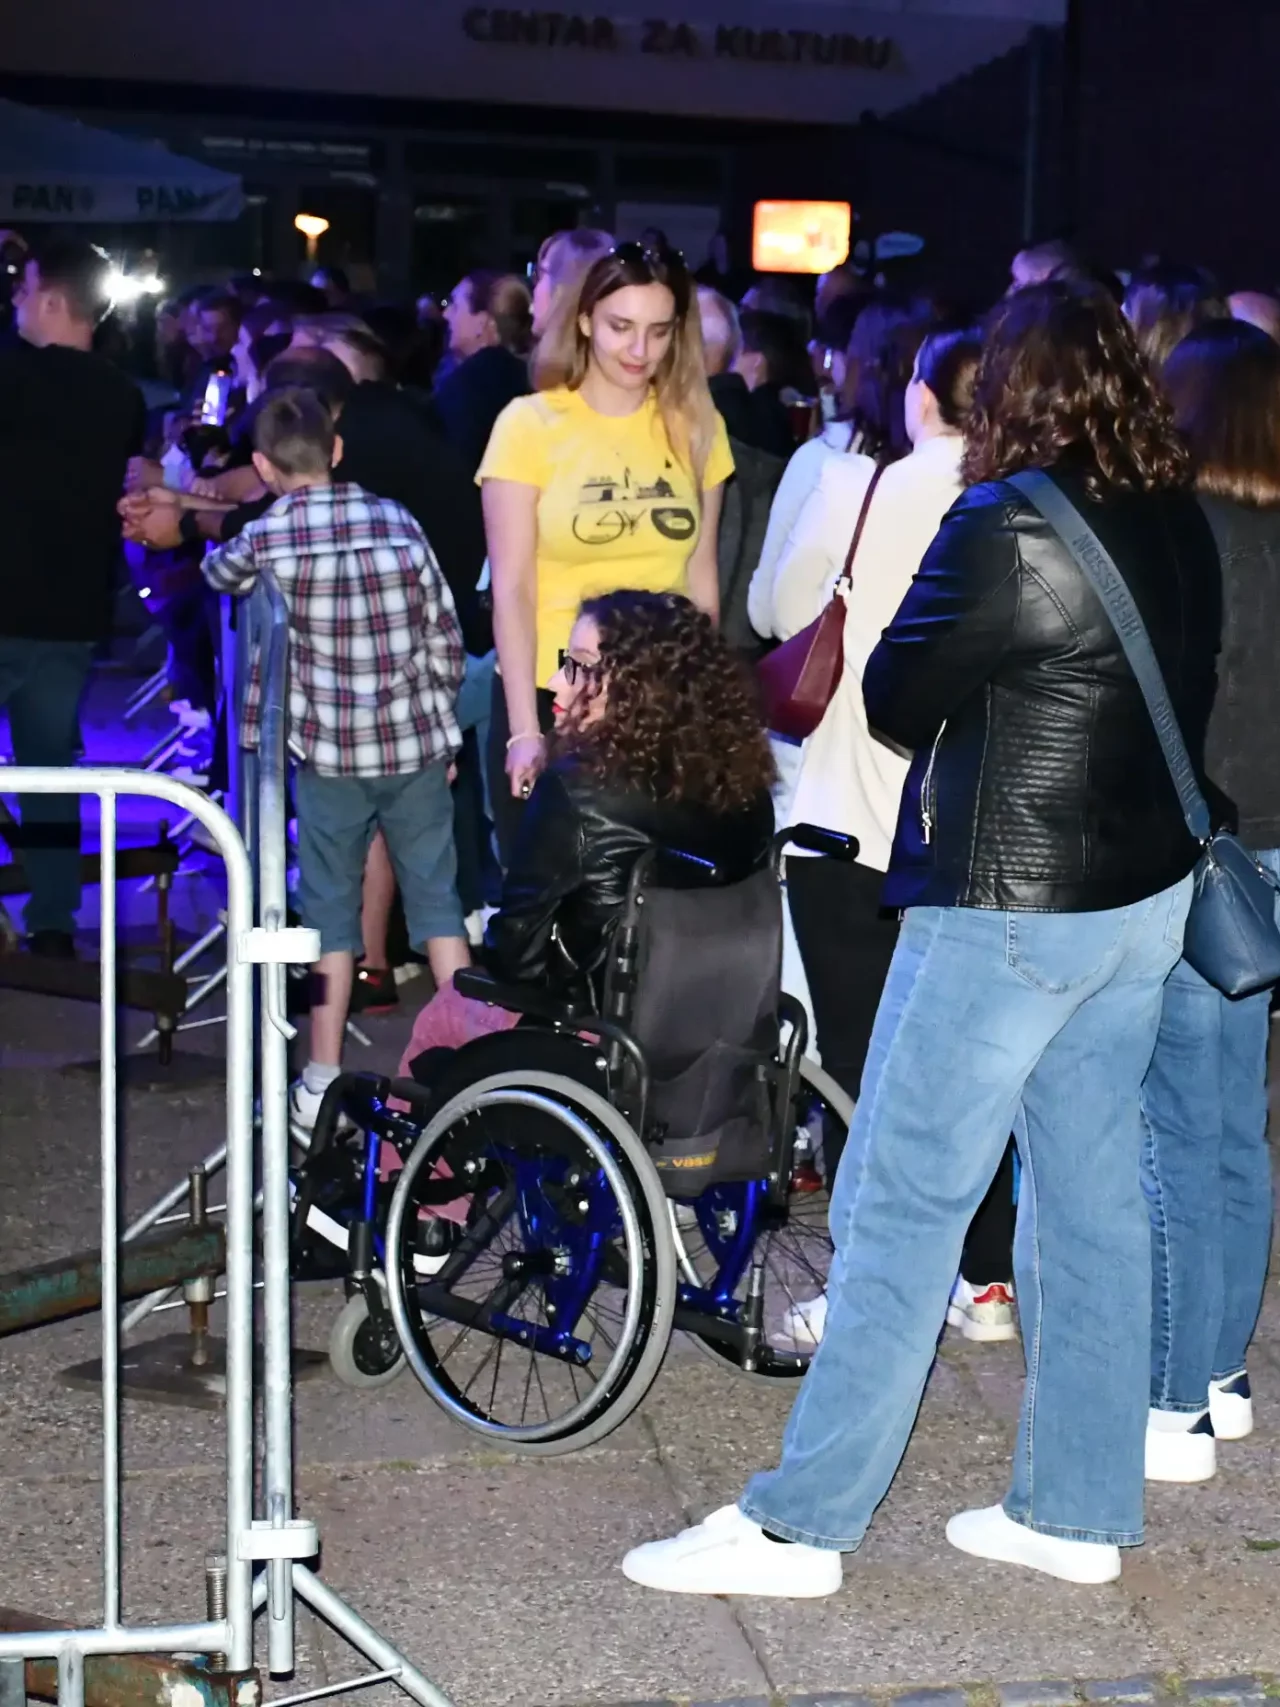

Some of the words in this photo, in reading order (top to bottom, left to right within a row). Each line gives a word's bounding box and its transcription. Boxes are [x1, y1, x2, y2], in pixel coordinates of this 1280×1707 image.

[463, 8, 615, 50] CENTAR
[641, 19, 699, 56] ZA
[715, 25, 892, 69] KULTURU
